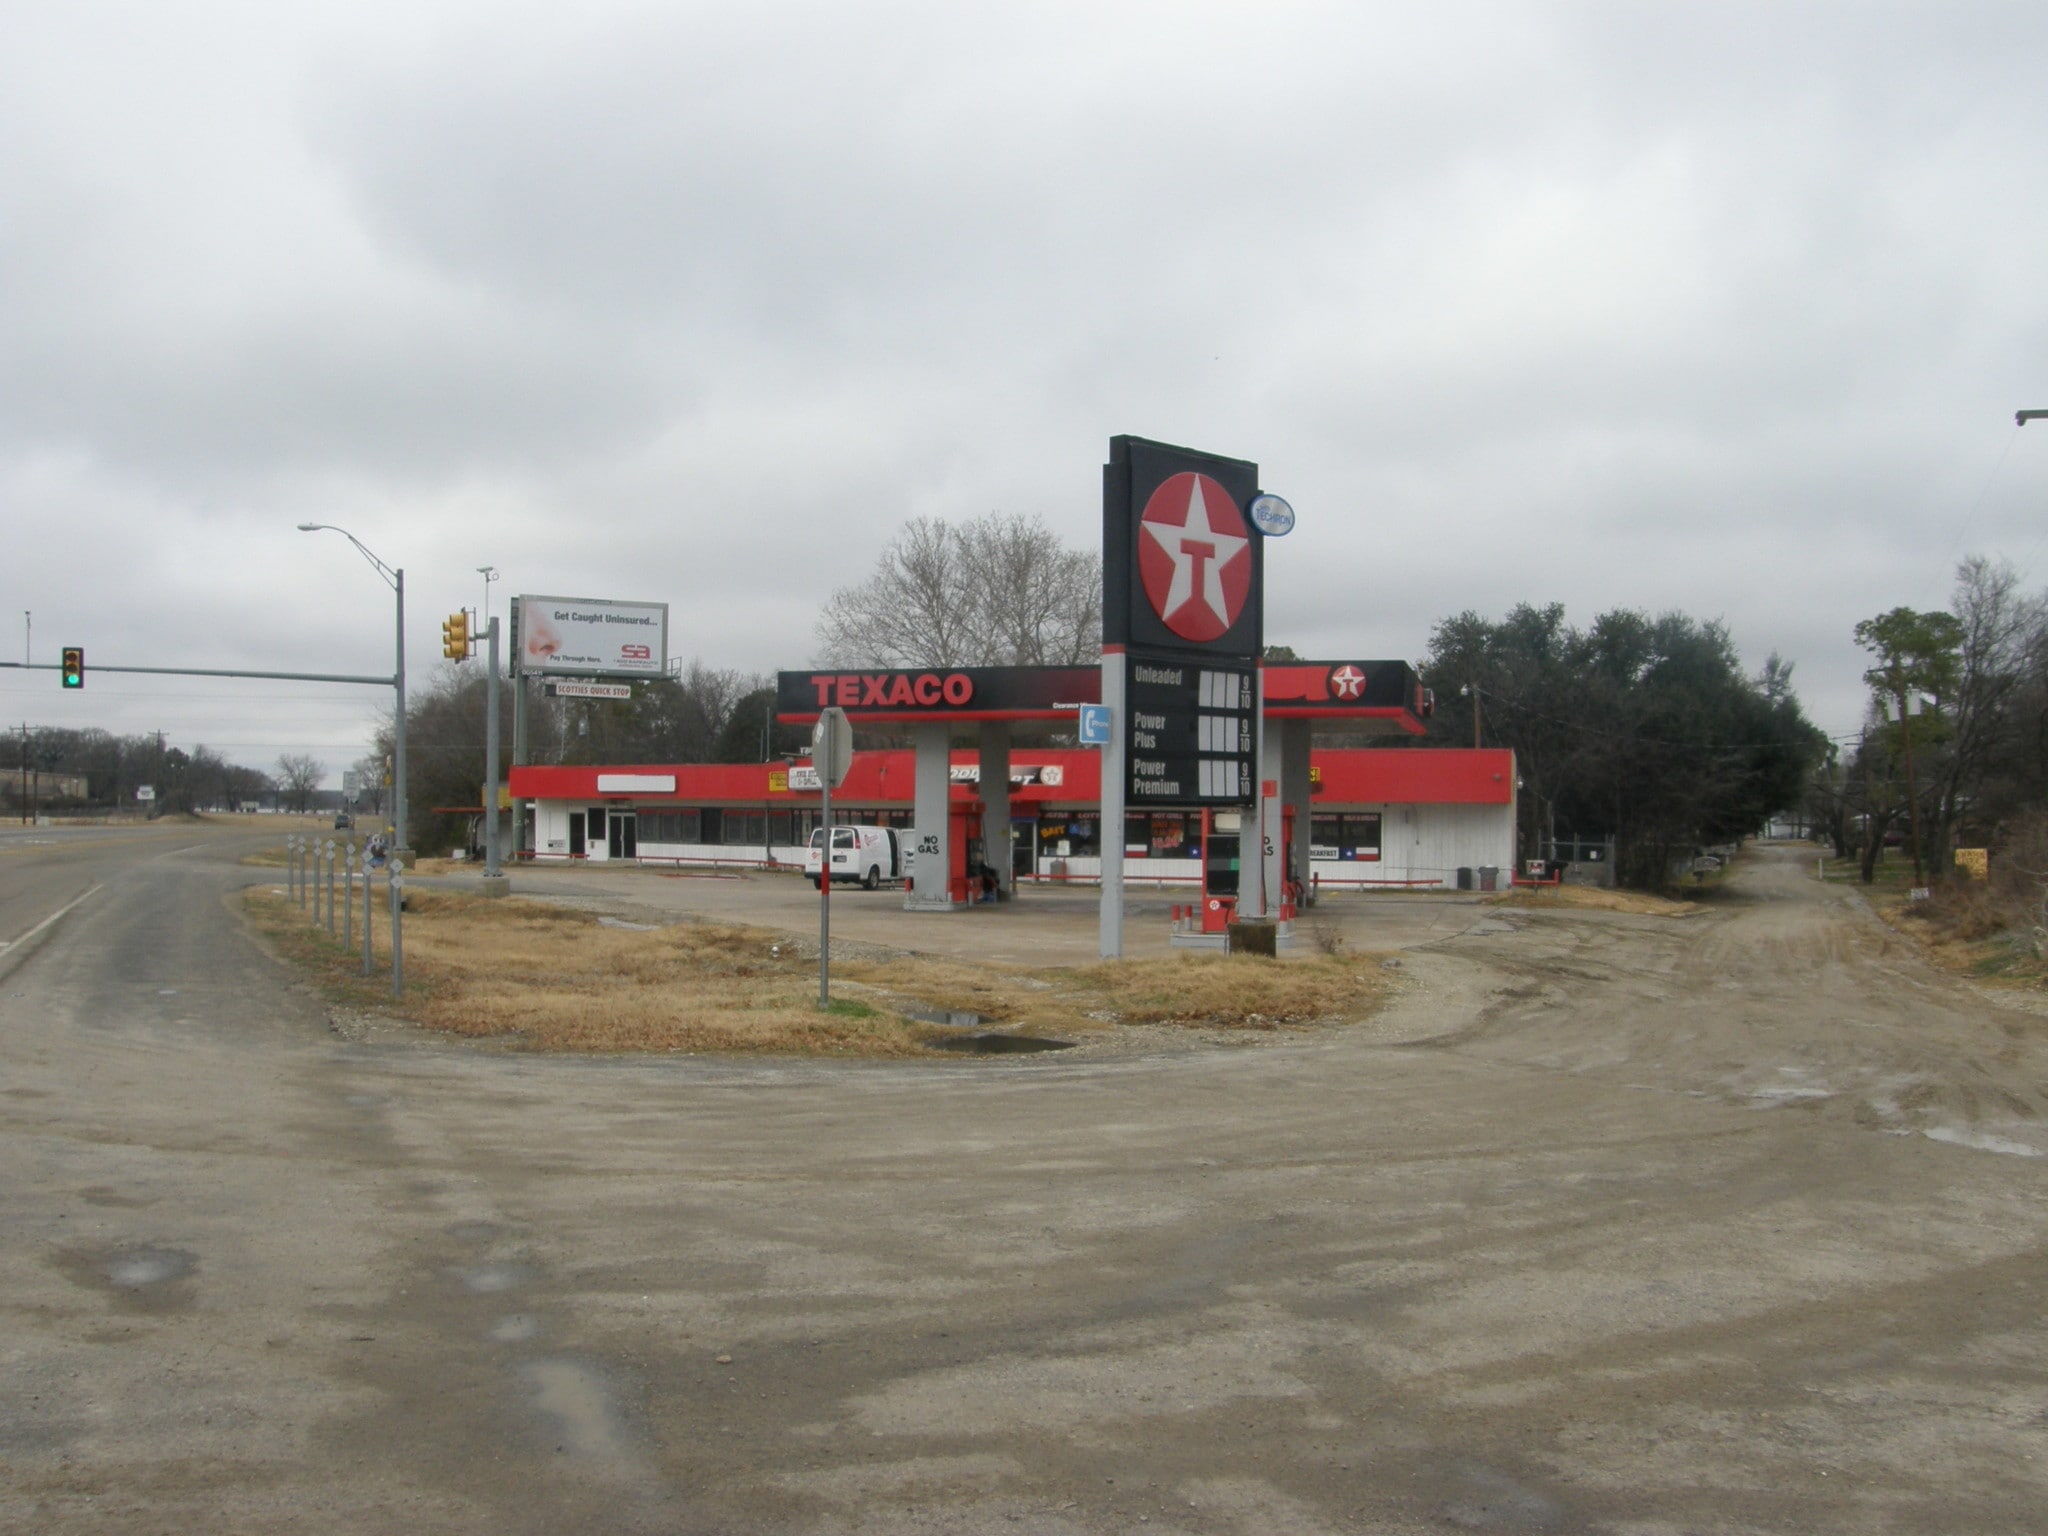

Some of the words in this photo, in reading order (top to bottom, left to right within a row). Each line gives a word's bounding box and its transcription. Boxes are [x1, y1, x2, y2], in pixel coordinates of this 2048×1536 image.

[554, 611, 569, 621] Get
[572, 612, 603, 624] Caught
[550, 654, 561, 663] Pay
[562, 655, 586, 664] Through
[1135, 665, 1182, 686] Unleaded
[558, 684, 588, 694] SCOTTIES
[590, 686, 611, 695] QUICK
[612, 687, 630, 696] STOP
[811, 673, 974, 706] TEXACO
[1241, 694, 1250, 709] 10
[1134, 712, 1166, 730] Power
[1134, 731, 1156, 749] Plus
[1241, 737, 1250, 753] 10
[1133, 758, 1166, 776] Power
[1133, 778, 1180, 795] Premium
[1241, 780, 1250, 796] 10
[1040, 824, 1066, 838] BAIT
[923, 835, 938, 844] NO
[918, 845, 940, 855] GAS
[1310, 849, 1337, 857] REAKFAST
